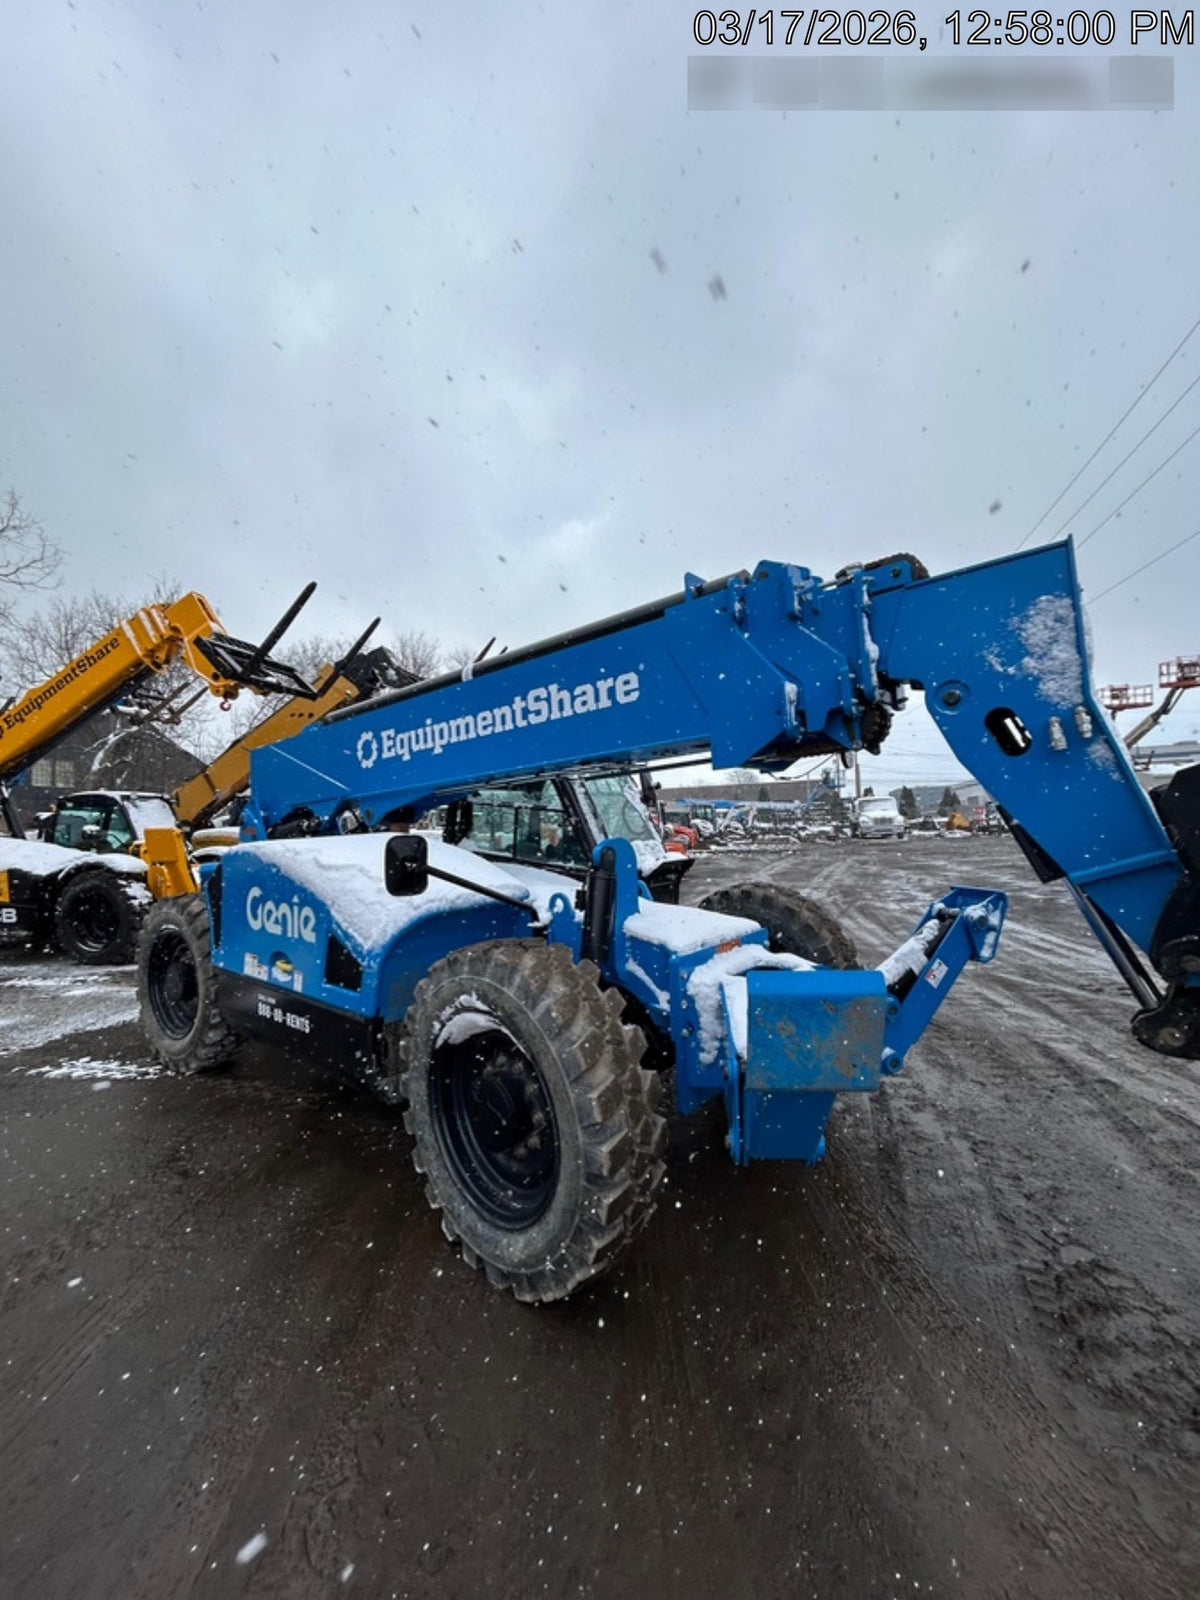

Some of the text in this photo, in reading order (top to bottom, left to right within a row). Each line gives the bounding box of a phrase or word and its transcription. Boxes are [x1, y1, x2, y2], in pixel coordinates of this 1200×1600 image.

[4, 637, 120, 730] EquipmentShare
[380, 671, 640, 761] EquipmentShare
[246, 886, 316, 943] Genie
